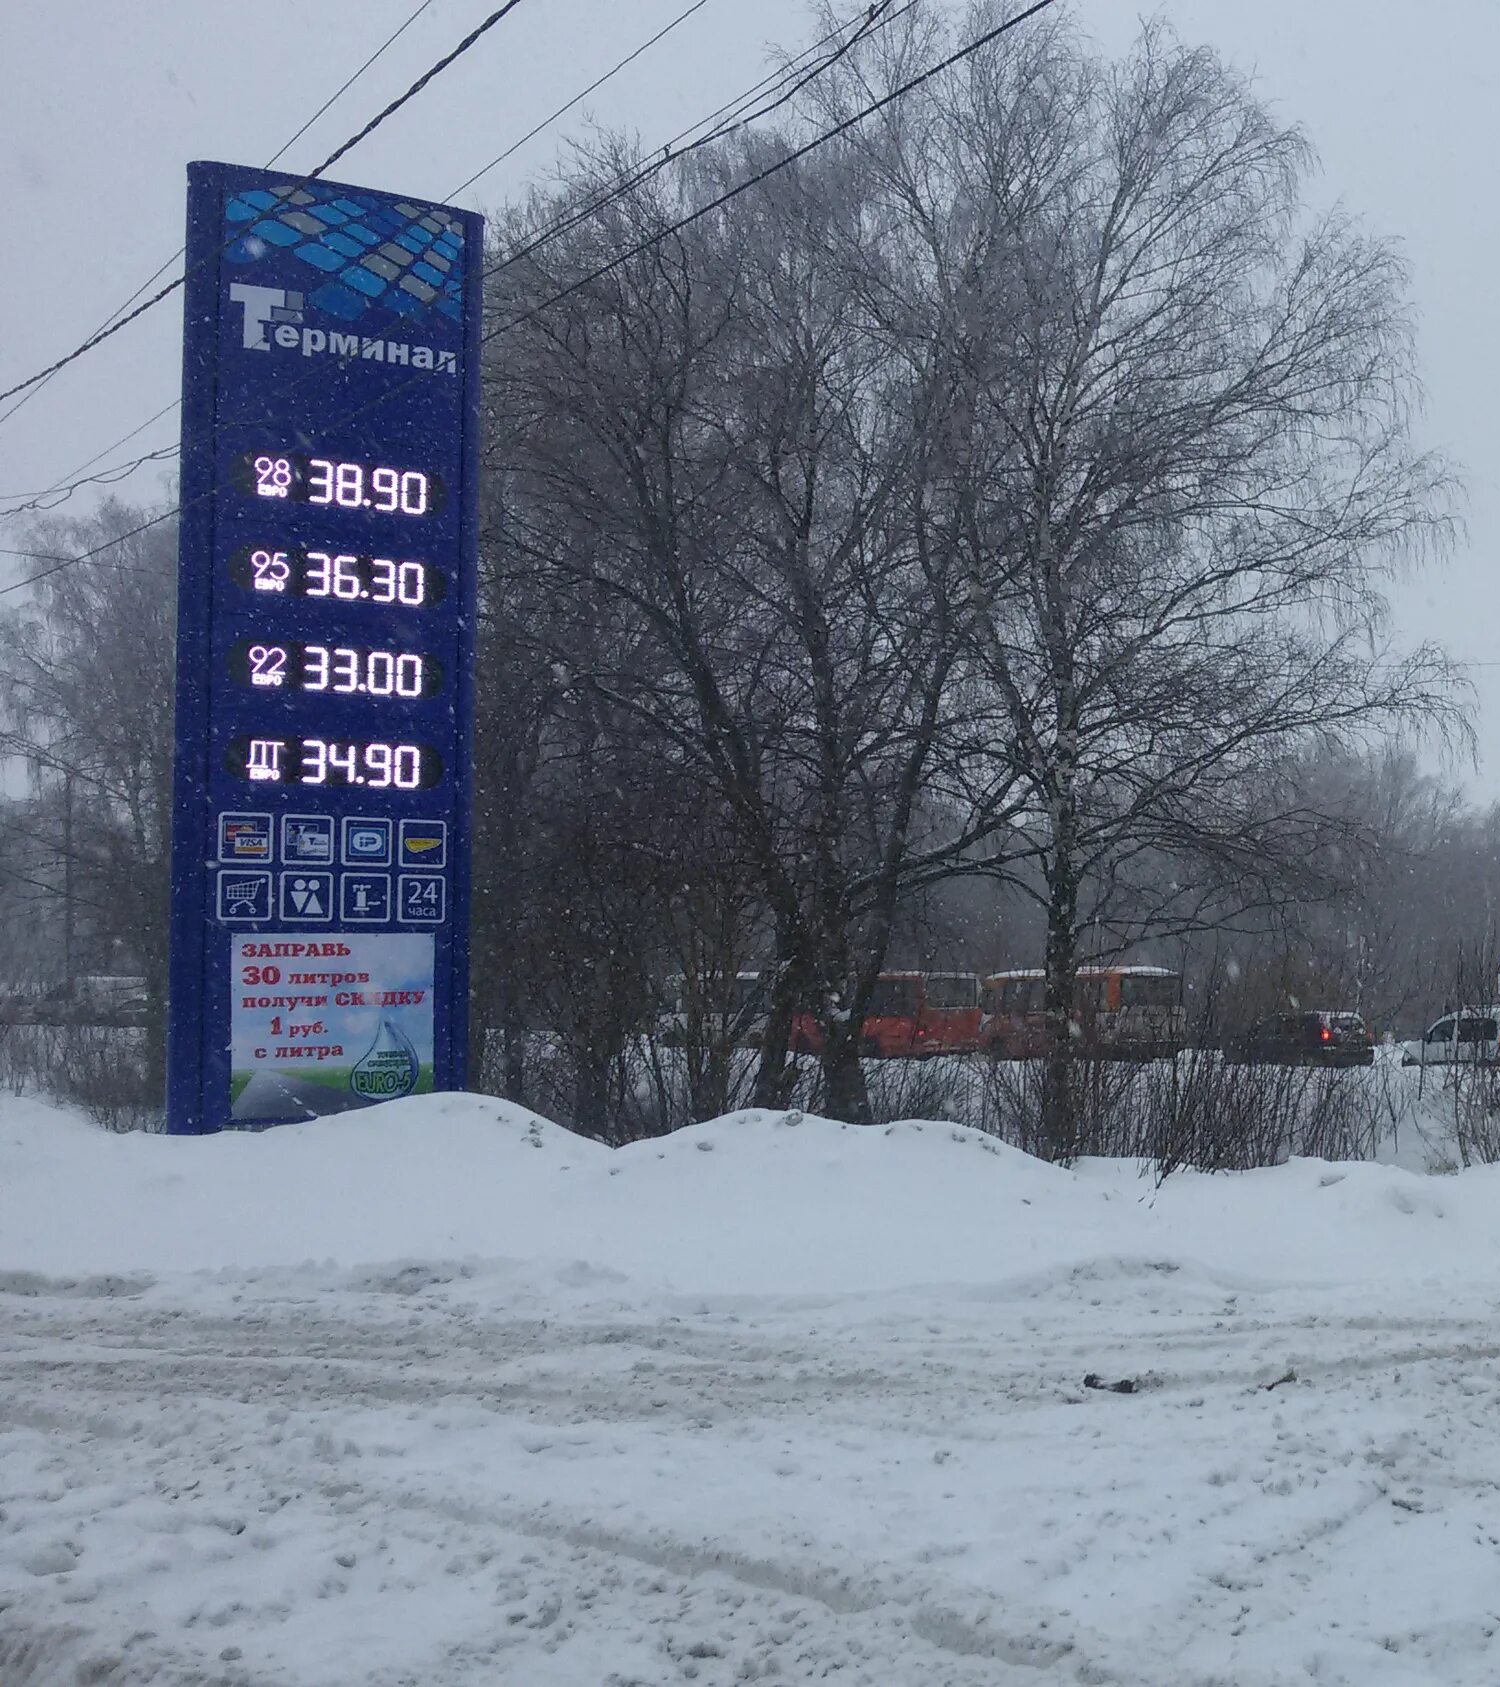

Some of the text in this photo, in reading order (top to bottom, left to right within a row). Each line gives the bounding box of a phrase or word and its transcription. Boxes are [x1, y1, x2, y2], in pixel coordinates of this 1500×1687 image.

[229, 282, 457, 374] Терминал
[254, 457, 427, 515] 98 38.90
[251, 550, 425, 606] 95 36.30
[248, 645, 422, 697] 92 33.00
[246, 739, 420, 789] ДТ 34.90
[239, 837, 264, 847] VISA
[408, 881, 438, 904] 24
[408, 907, 437, 917] часа
[242, 943, 351, 958] ЗАПРАВЬ
[242, 965, 370, 987] 30 литров
[242, 991, 425, 1011] получи СКДКУ
[271, 1016, 328, 1038] 1 руб.
[254, 1044, 344, 1060] с литра
[354, 1070, 412, 1094] EURO-5
